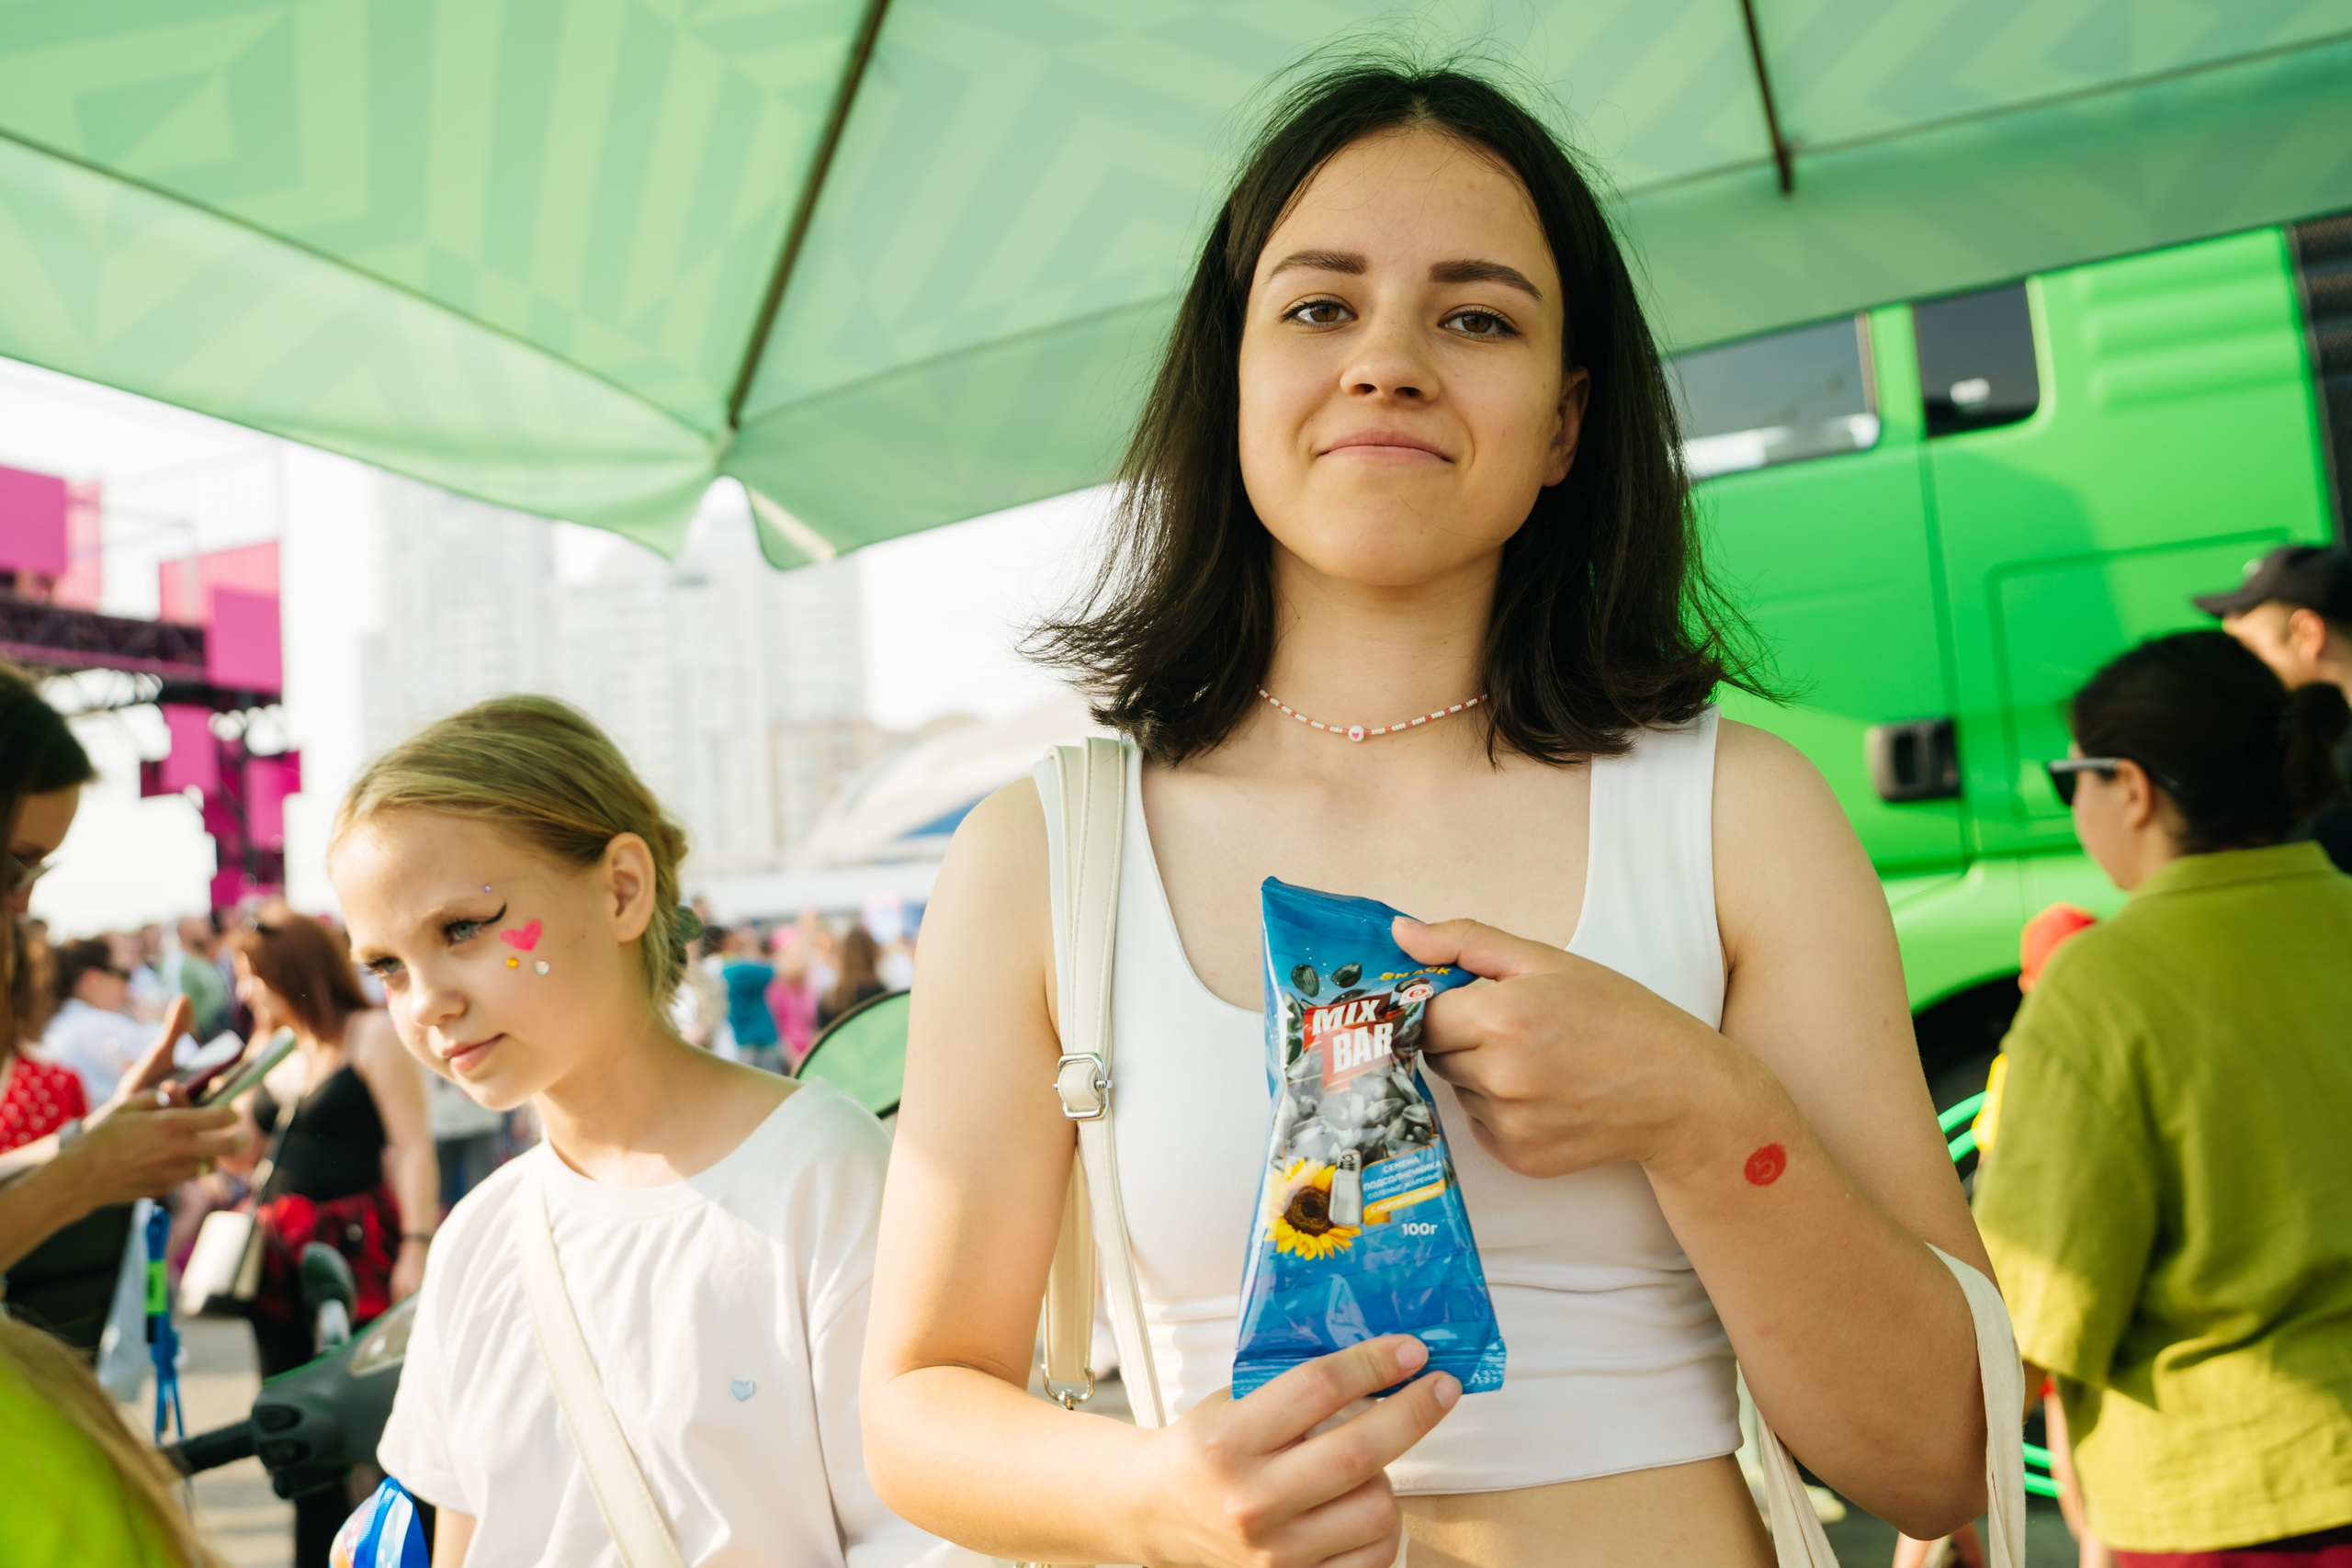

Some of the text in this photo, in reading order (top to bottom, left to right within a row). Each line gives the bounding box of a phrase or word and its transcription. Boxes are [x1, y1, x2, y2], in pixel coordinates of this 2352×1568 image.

[1379, 966, 1452, 981] SNACK
[1312, 999, 1381, 1036] MIX
[1332, 1022, 1394, 1074] BAR
[1363, 1160, 1442, 1191] ПОДСОЛНЕЧНИКА
[1382, 1156, 1420, 1173] СЕМЕНА
[1401, 1222, 1438, 1236] 100г
